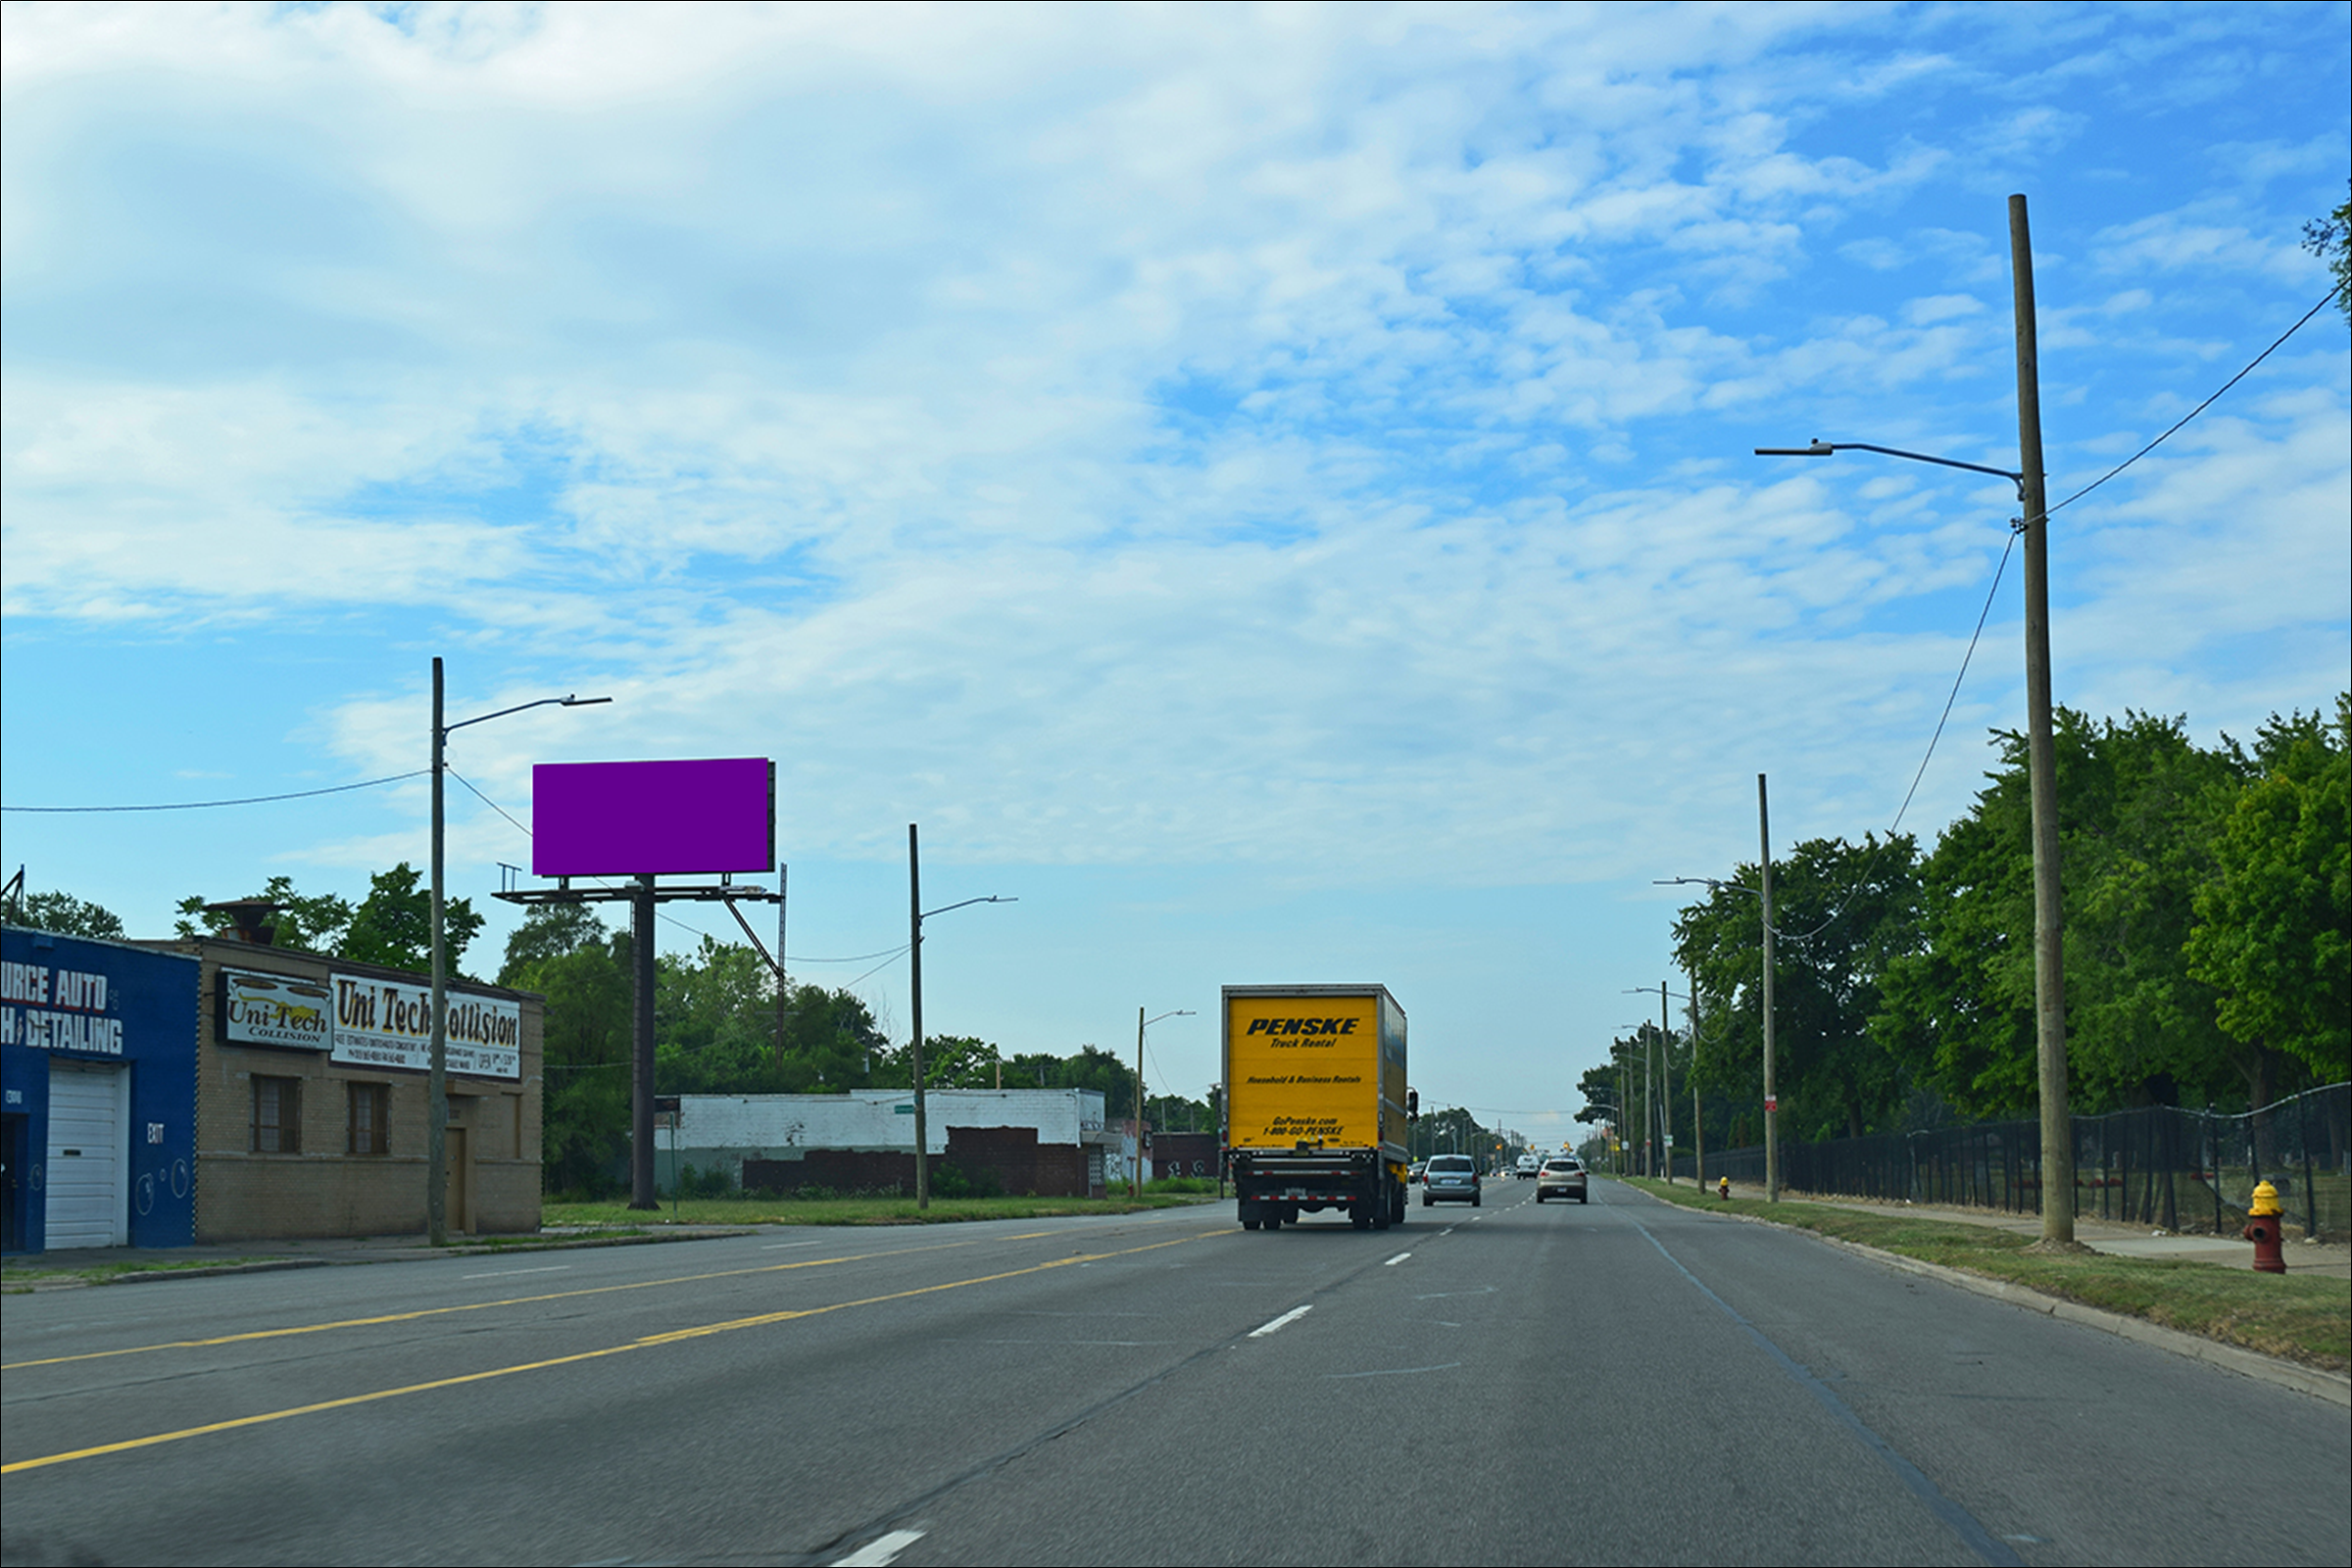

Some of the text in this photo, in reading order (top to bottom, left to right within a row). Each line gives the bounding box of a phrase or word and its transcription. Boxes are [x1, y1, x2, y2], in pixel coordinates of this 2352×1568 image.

[54, 968, 108, 1014] AUTO
[336, 979, 518, 1048] Uni Tech ollision
[25, 1008, 123, 1055] DETAILING
[248, 1026, 321, 1043] COLLISION
[1247, 1018, 1360, 1036] PENSKE
[1270, 1038, 1337, 1049] Truck Rental
[1272, 1116, 1338, 1126] GoPenske.com
[148, 1123, 165, 1144] EXIT
[1263, 1126, 1344, 1136] 1-800-GO-PENSKE
